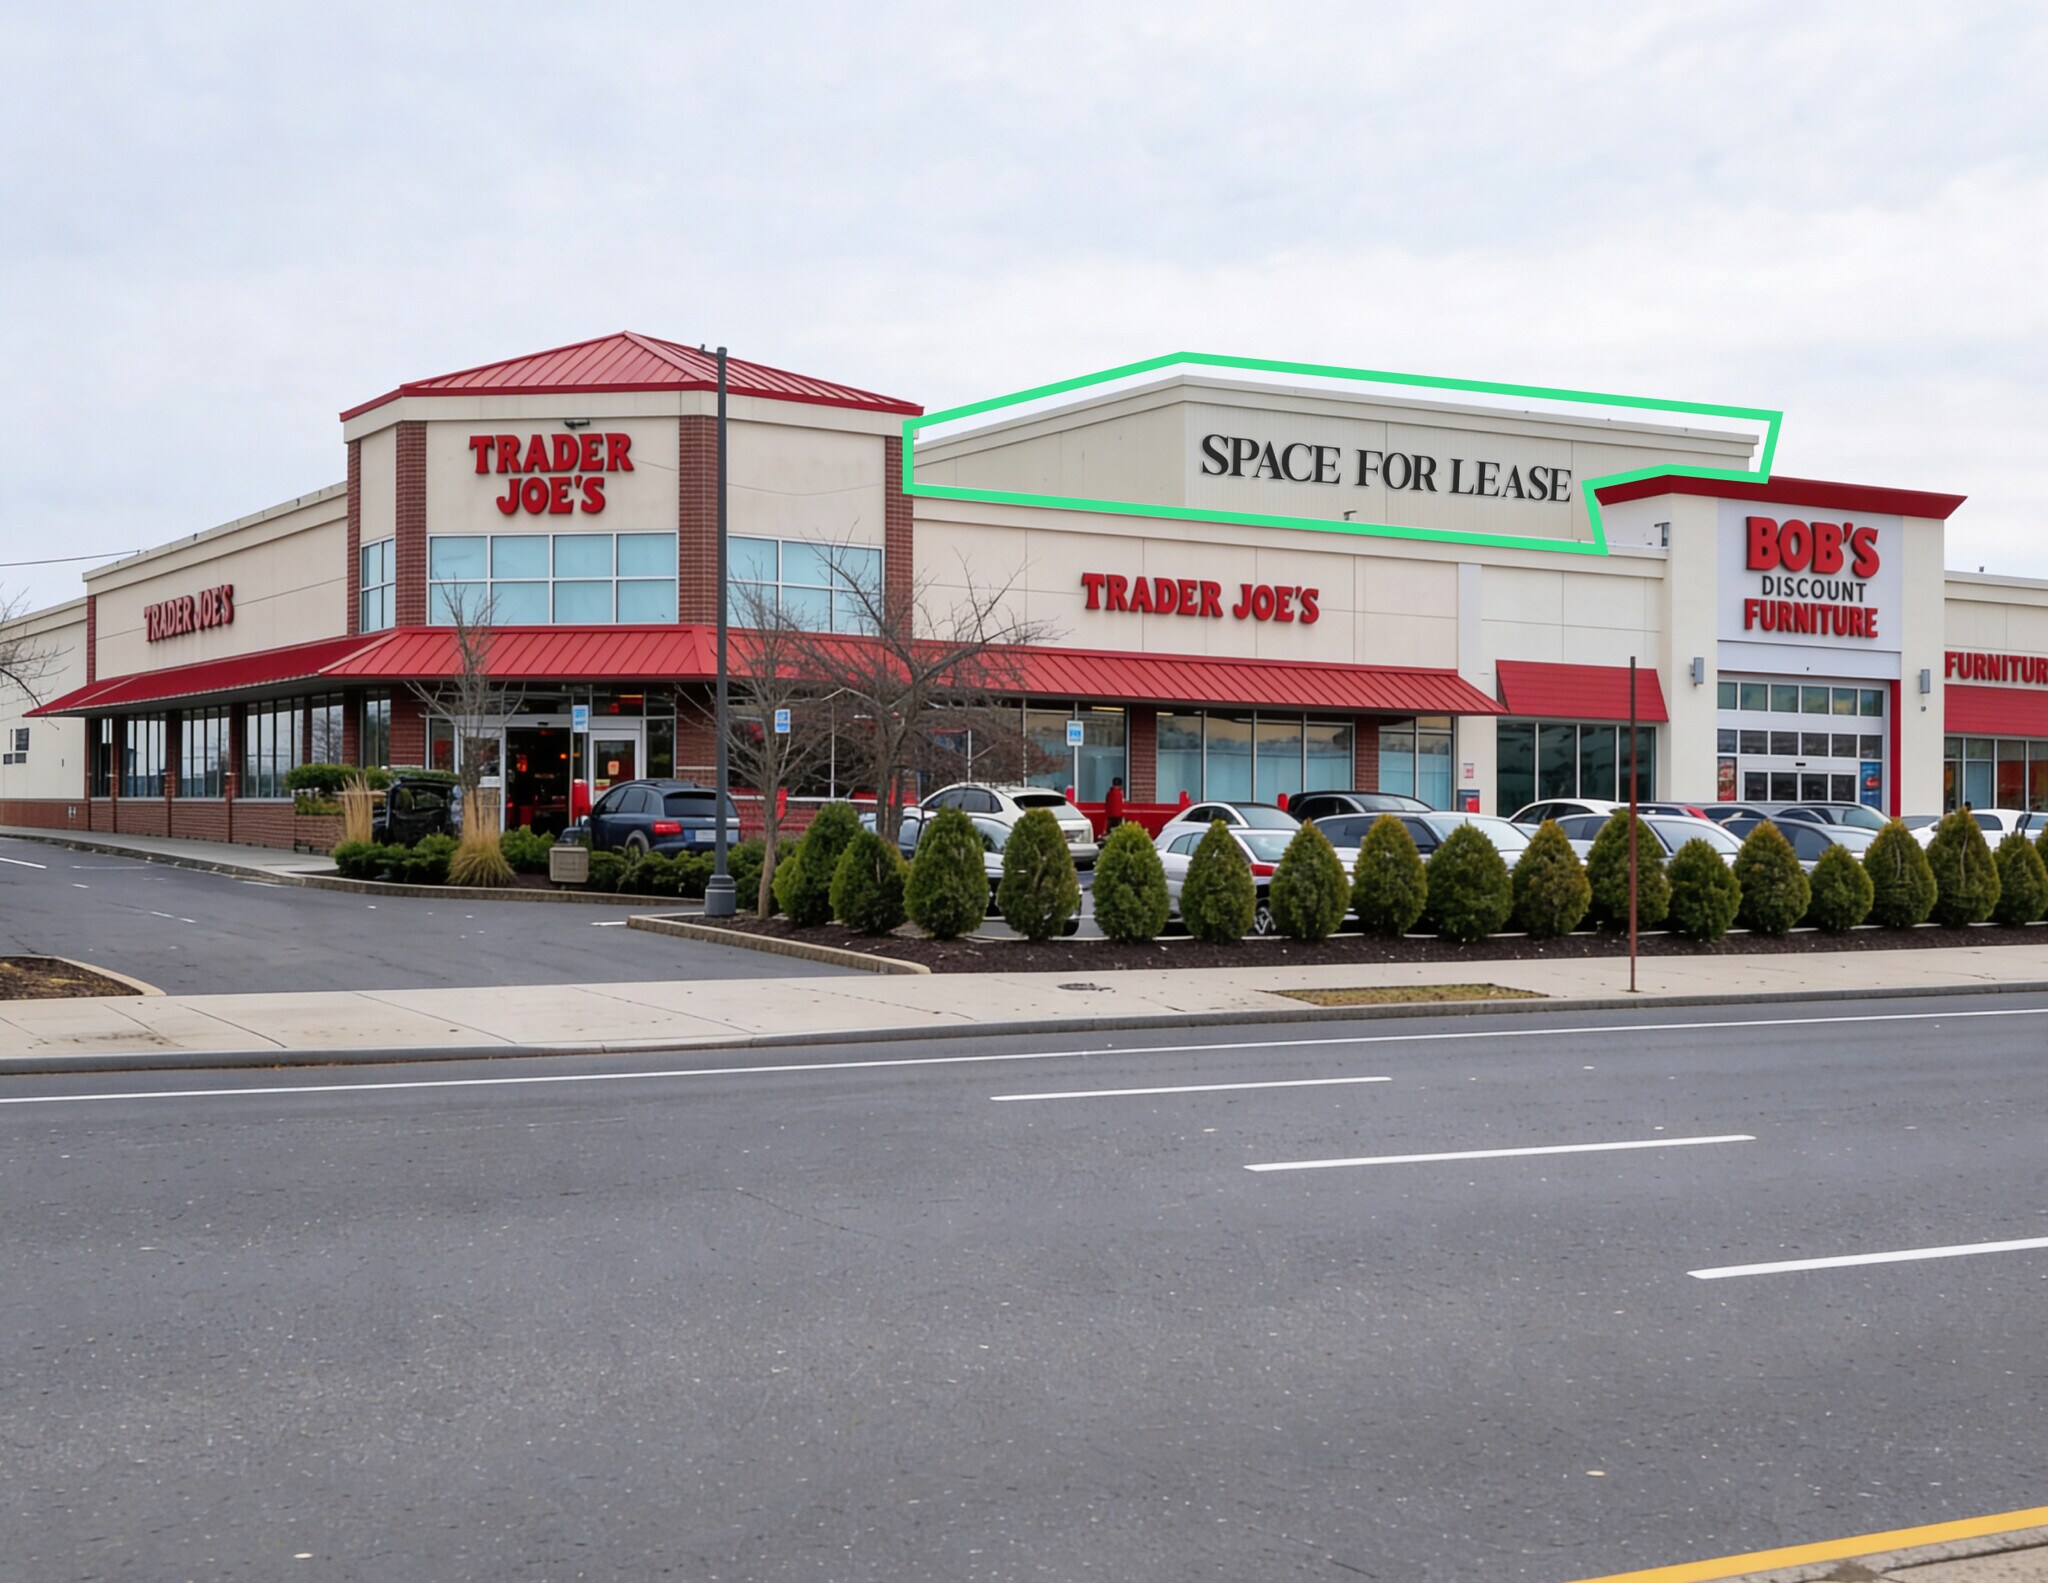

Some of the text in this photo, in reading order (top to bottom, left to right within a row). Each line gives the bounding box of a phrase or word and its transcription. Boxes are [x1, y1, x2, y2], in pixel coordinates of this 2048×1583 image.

[469, 433, 635, 475] TRADER
[1201, 433, 1572, 503] SPACE FOR LEASE
[496, 475, 607, 516] JOE'S
[1746, 516, 1880, 579] BOB'S
[1081, 572, 1320, 625] TRADER JOE'S
[1762, 575, 1868, 603] DISCOUNT
[144, 584, 235, 643] TRADER JOE'S
[1744, 598, 1879, 639] FURNITURE
[1944, 651, 2048, 685] FURNITUR
